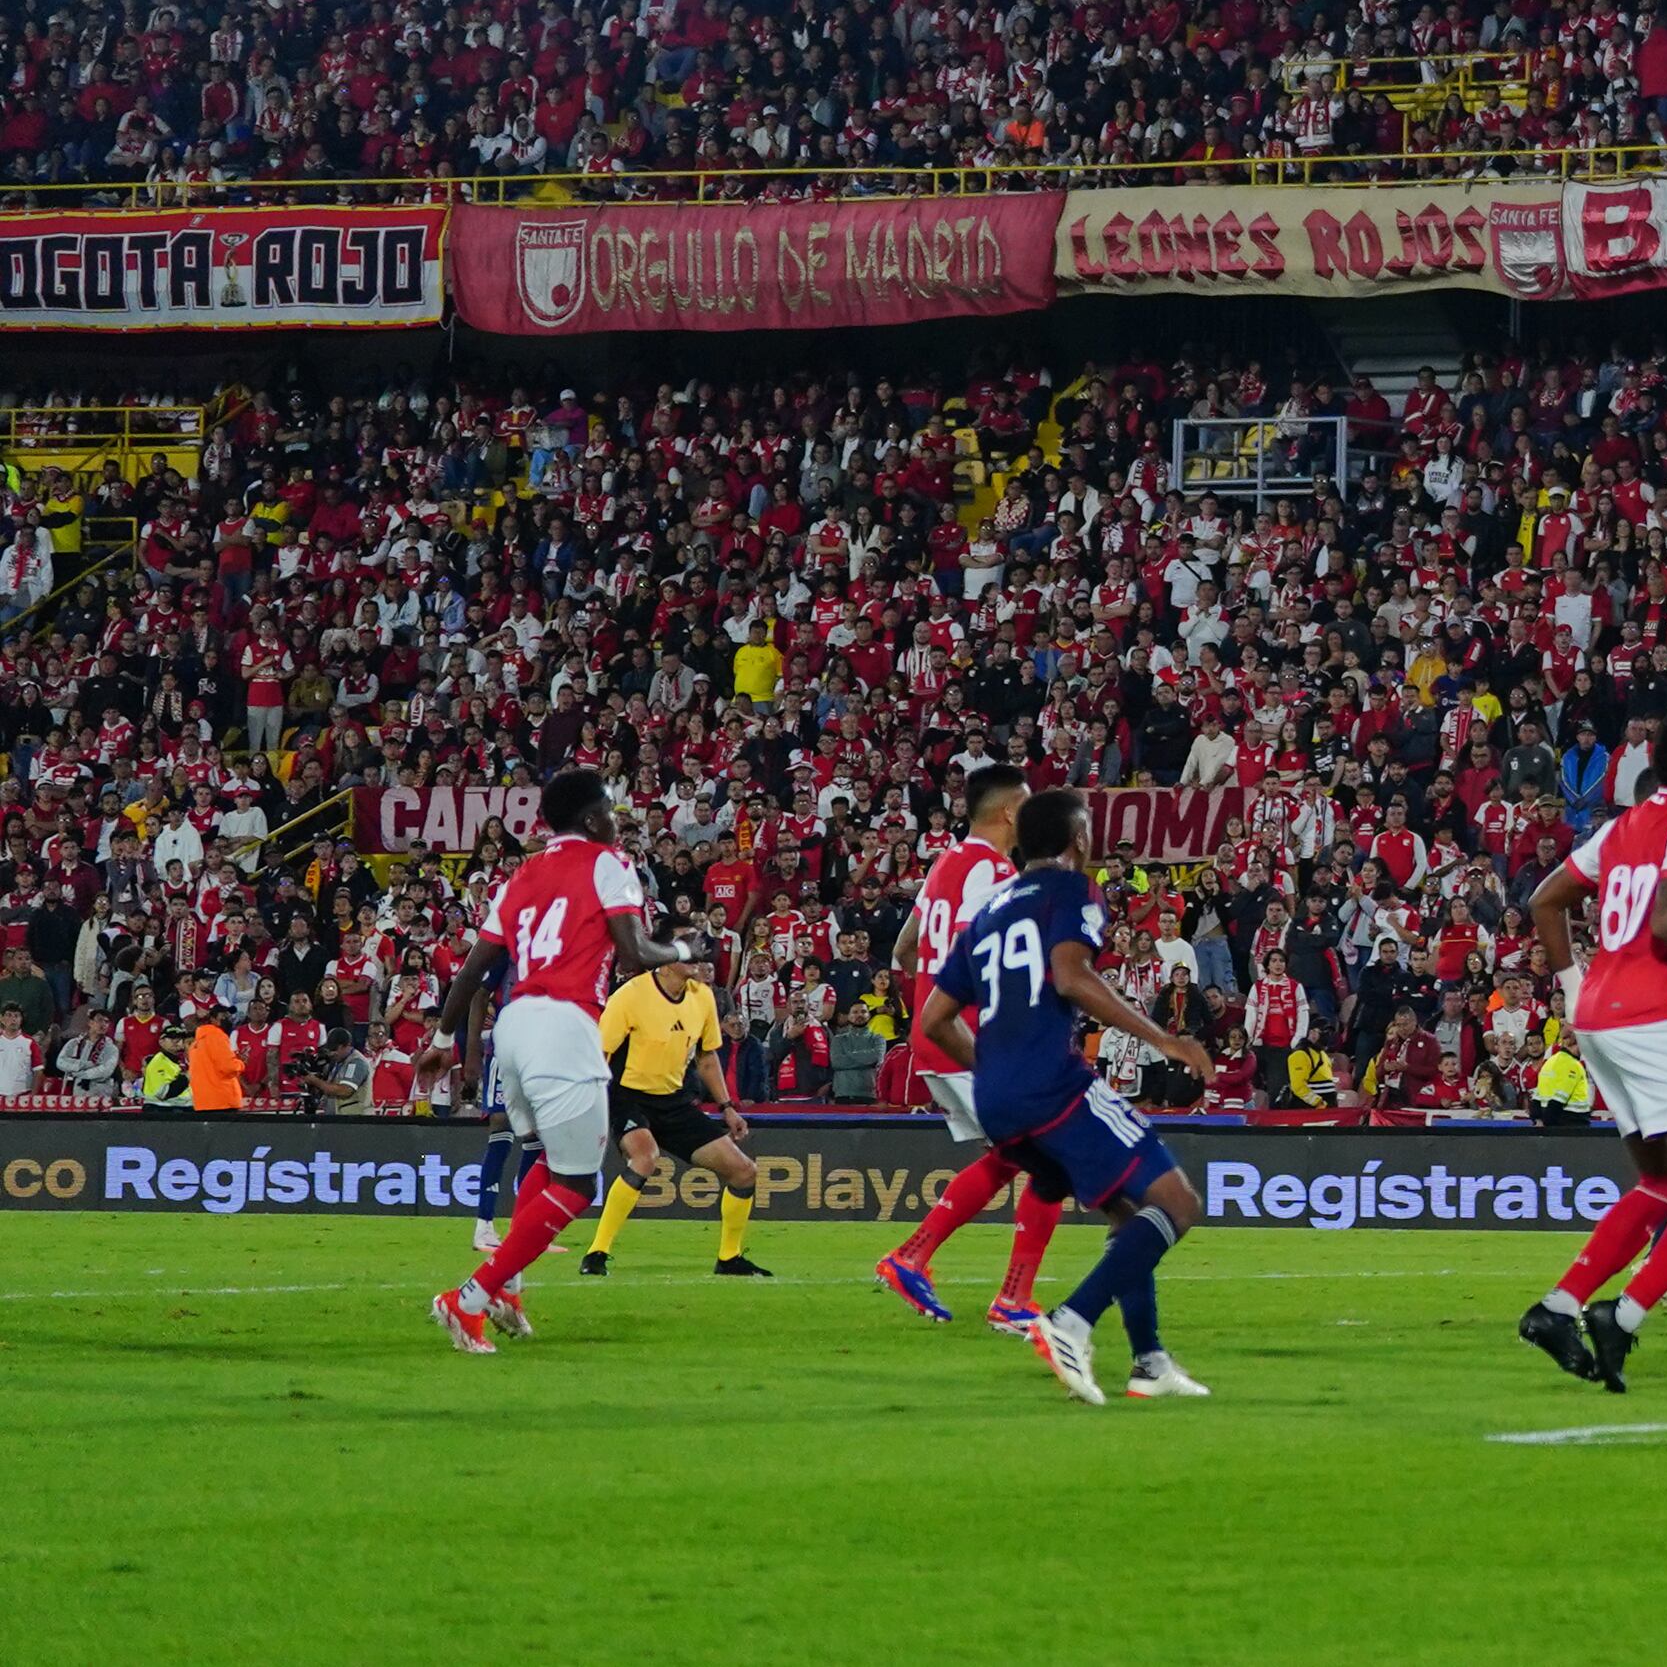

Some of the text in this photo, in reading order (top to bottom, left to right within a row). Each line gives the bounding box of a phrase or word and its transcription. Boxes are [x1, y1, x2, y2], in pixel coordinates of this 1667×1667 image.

[521, 227, 581, 245] SANTA FE
[1070, 202, 1488, 284] LEONES ROJOS
[1491, 207, 1558, 226] SANTA FE
[253, 225, 428, 307] ROJO
[591, 225, 757, 314] ORGULLO
[779, 222, 830, 311] DE
[517, 897, 569, 983] 14
[973, 918, 1044, 1027] 39
[105, 1145, 483, 1213] Regístrate
[1207, 1160, 1622, 1230] Regístrate
